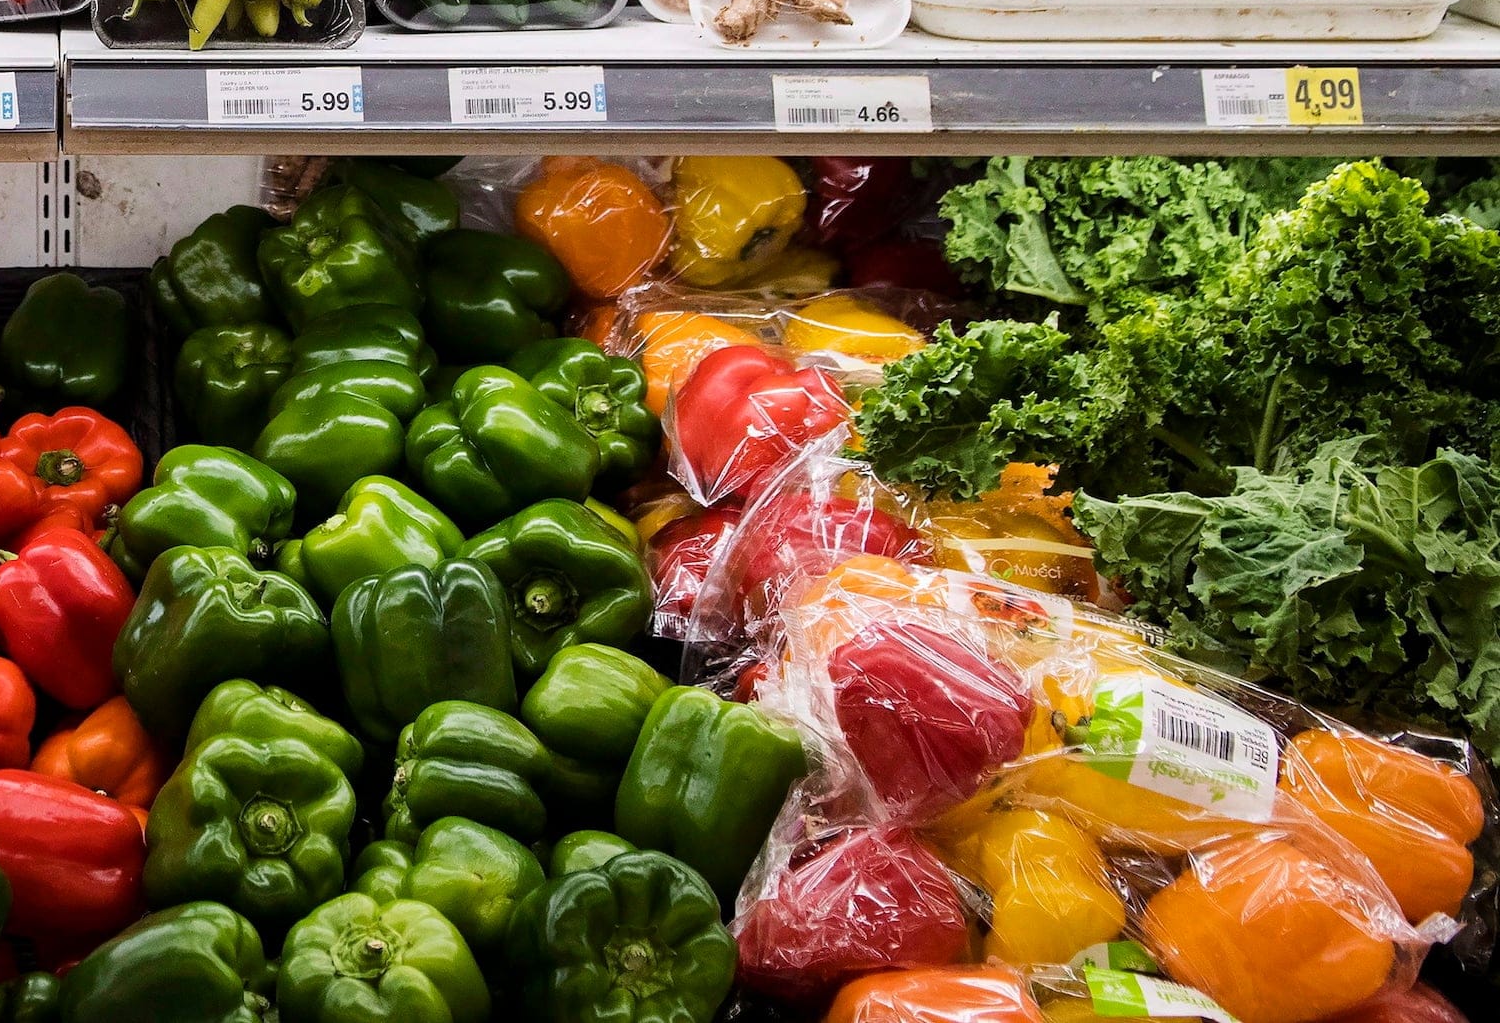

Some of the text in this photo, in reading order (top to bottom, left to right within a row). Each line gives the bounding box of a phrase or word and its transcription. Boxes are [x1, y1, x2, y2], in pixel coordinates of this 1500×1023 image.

[301, 92, 350, 111] 5.99
[543, 91, 592, 110] 5.99
[1294, 78, 1355, 110] 4.99
[857, 105, 900, 122] 4.66
[1013, 562, 1062, 580] Mucci
[1242, 743, 1269, 766] BELL
